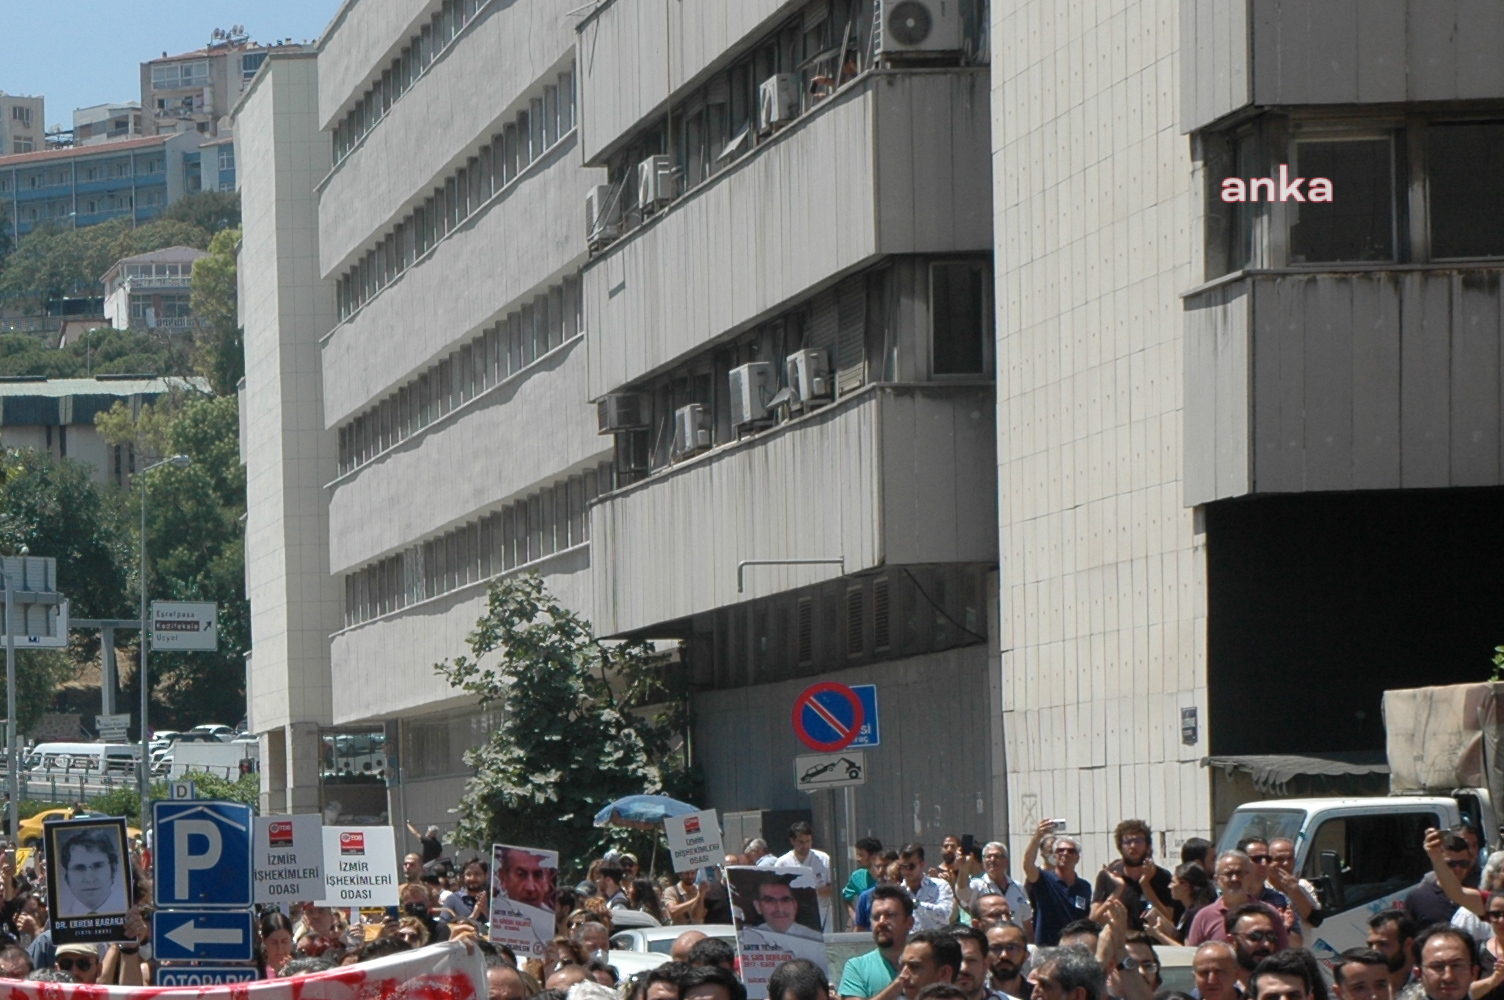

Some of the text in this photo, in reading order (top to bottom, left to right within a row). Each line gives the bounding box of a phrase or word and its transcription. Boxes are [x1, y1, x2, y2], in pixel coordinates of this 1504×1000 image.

[177, 785, 188, 798] D
[174, 819, 222, 900] P
[268, 853, 297, 866] İZMİR
[339, 861, 369, 872] İZMİR
[254, 866, 319, 881] İŞHEKİMLERİ
[326, 873, 392, 886] İŞHEKİMLERİ
[268, 883, 300, 895] ODASI
[340, 889, 372, 899] ODASI
[95, 917, 125, 927] KARAKA
